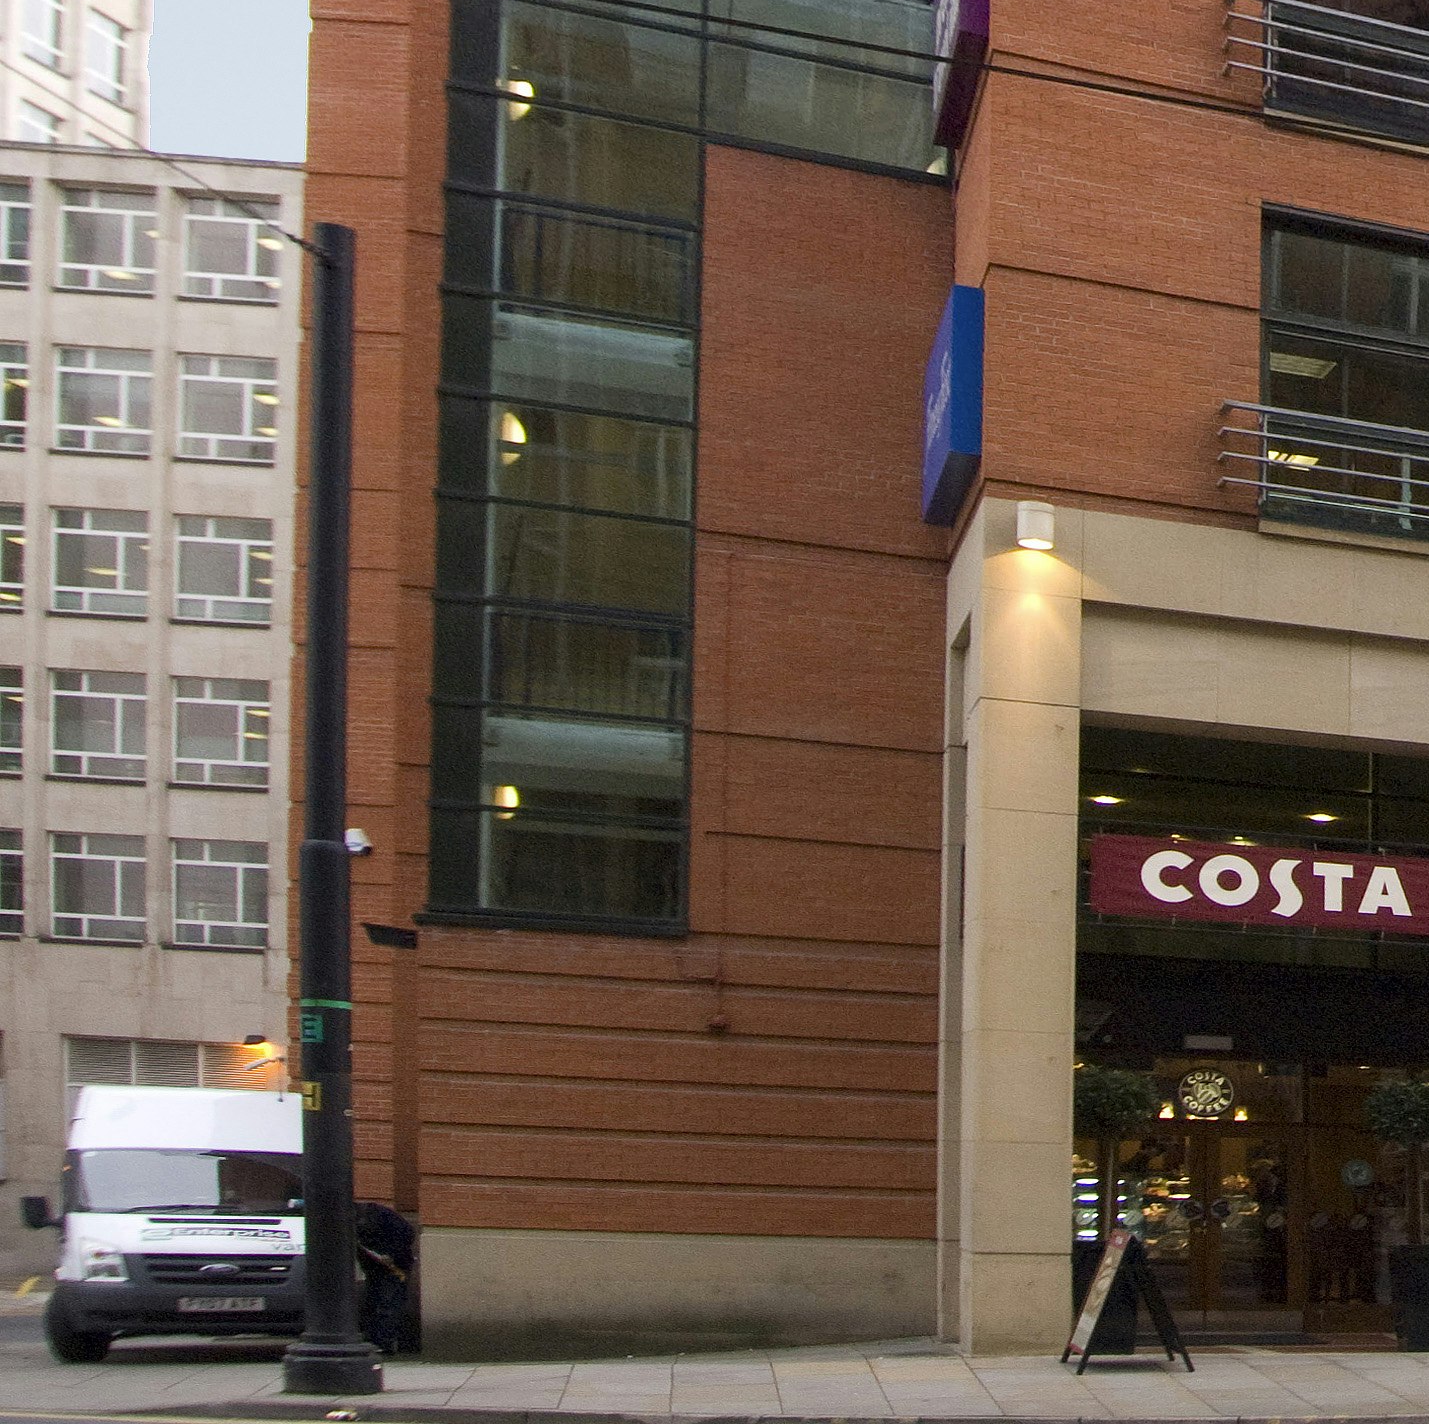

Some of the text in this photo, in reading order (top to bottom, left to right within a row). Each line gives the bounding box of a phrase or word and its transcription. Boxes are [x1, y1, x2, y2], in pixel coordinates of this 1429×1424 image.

[1140, 849, 1413, 918] COSTA
[1187, 1072, 1225, 1085] COSTA
[1184, 1096, 1230, 1113] COFFEE
[173, 1227, 290, 1239] Enterprise
